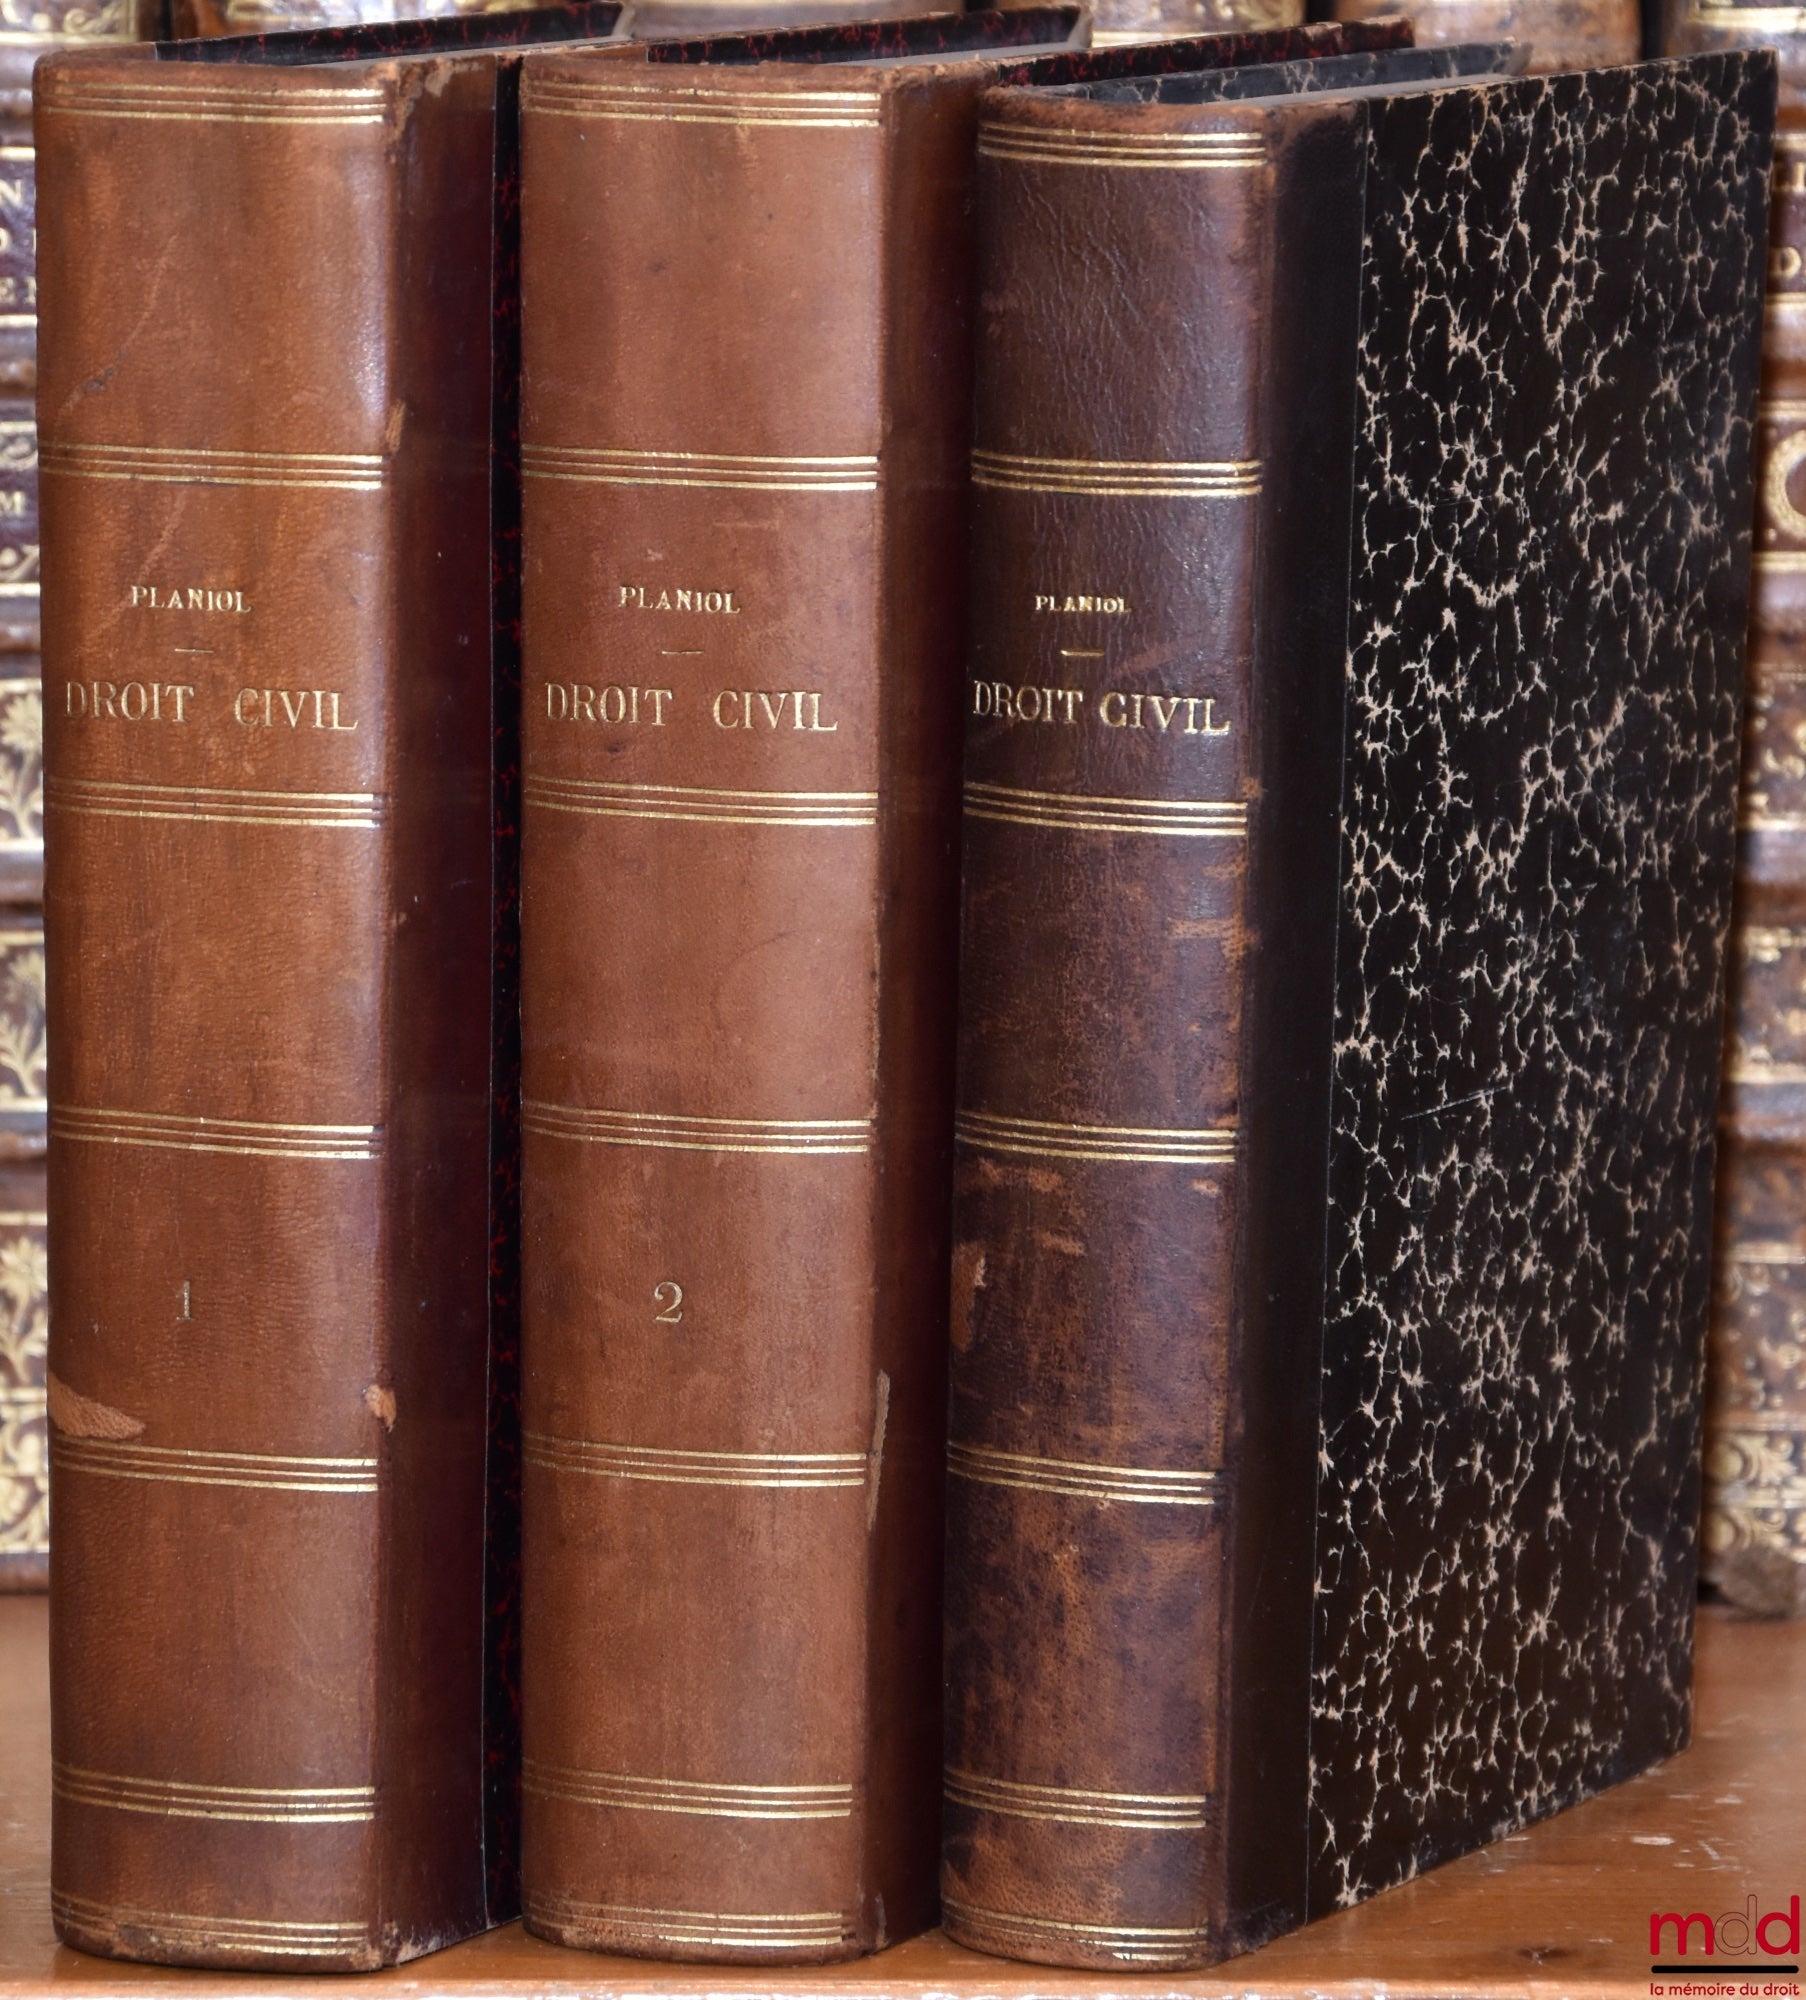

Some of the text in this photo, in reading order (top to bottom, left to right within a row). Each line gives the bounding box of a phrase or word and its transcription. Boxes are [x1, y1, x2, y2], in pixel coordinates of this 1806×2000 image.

[131, 585, 251, 613] PLANIOL
[618, 586, 741, 614] PLANIOL
[1034, 595, 1132, 615] PLANIOL
[64, 680, 359, 731] DROIT CIVIL
[545, 682, 839, 732] DROIT CIVIL
[973, 680, 1231, 737] DROIT CIVIL
[654, 1281, 683, 1323] 2
